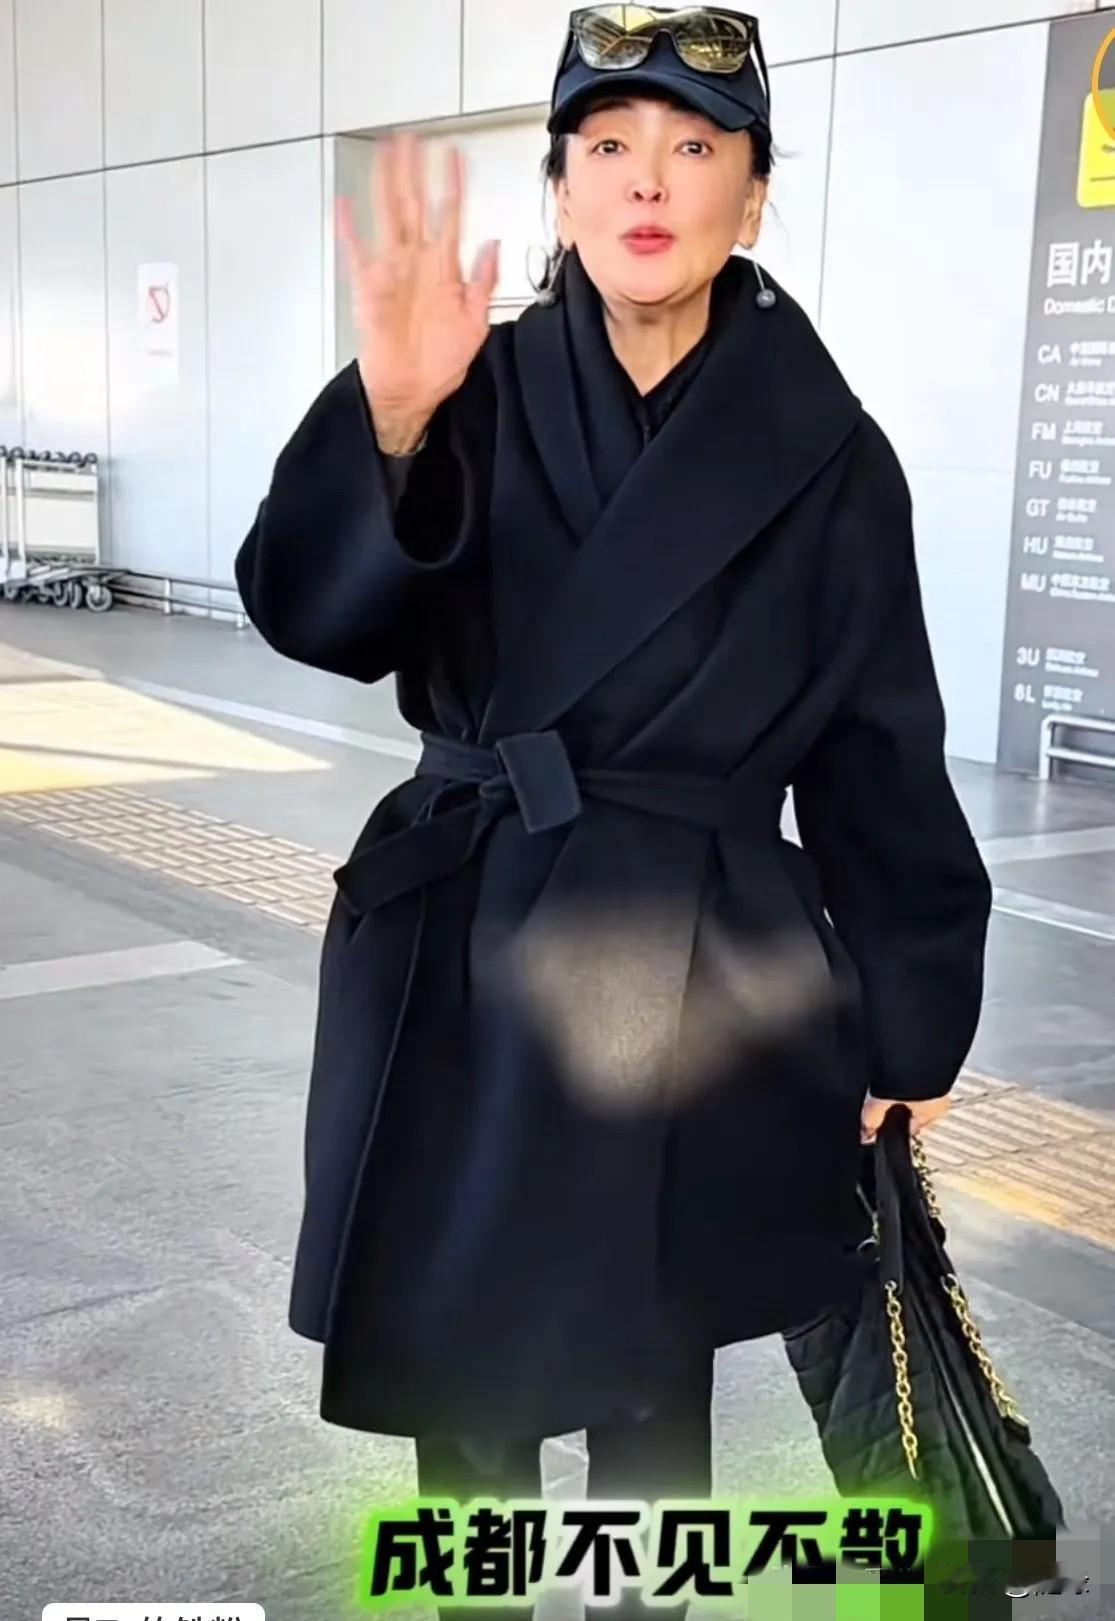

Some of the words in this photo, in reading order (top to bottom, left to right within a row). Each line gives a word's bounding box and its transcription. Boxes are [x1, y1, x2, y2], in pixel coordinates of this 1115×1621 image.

[1046, 239, 1113, 288] 国内
[1037, 344, 1061, 365] CA
[1034, 383, 1060, 402] CN
[1031, 422, 1056, 440] FM
[1028, 460, 1052, 480] FU
[1025, 498, 1050, 517] GT
[1023, 536, 1048, 555] HU
[1021, 572, 1046, 592] MU
[1016, 646, 1040, 666] 3U
